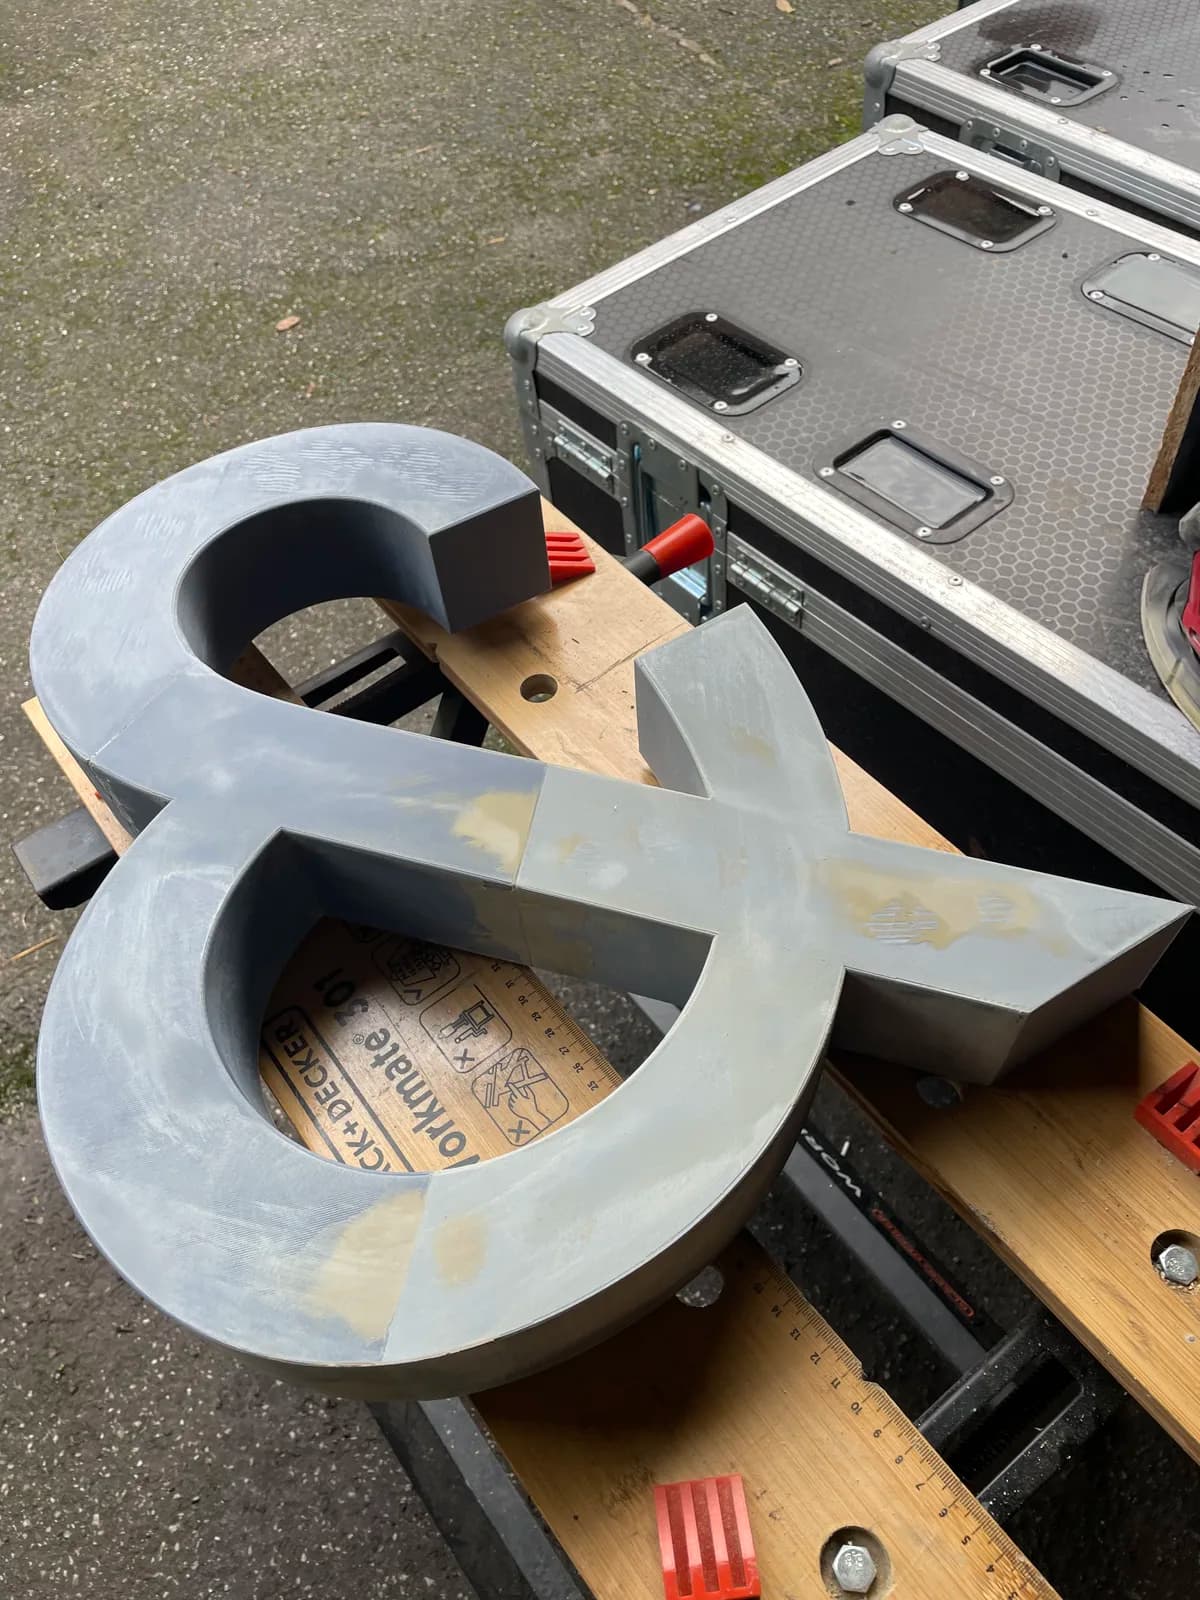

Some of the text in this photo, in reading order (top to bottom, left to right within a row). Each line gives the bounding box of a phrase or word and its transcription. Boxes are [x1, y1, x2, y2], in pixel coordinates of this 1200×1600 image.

[505, 979, 514, 989] 31
[314, 968, 368, 1027] 301
[518, 995, 529, 1006] 30
[531, 1011, 542, 1022] 29
[544, 1027, 555, 1038] 28
[558, 1046, 570, 1055] 27
[573, 1062, 584, 1074] 26
[587, 1080, 599, 1091] 25
[276, 1018, 390, 1171] CK+DECKER
[770, 1305, 783, 1318] 14
[790, 1328, 801, 1341] 13
[810, 1351, 821, 1365] 12
[830, 1377, 841, 1389] 11
[850, 1402, 863, 1415] 10
[873, 1429, 882, 1438] 9
[895, 1455, 904, 1465] 8
[916, 1482, 926, 1491] 7
[938, 1508, 948, 1518] 6
[961, 1535, 971, 1545] 5
[986, 1564, 995, 1573] 4
